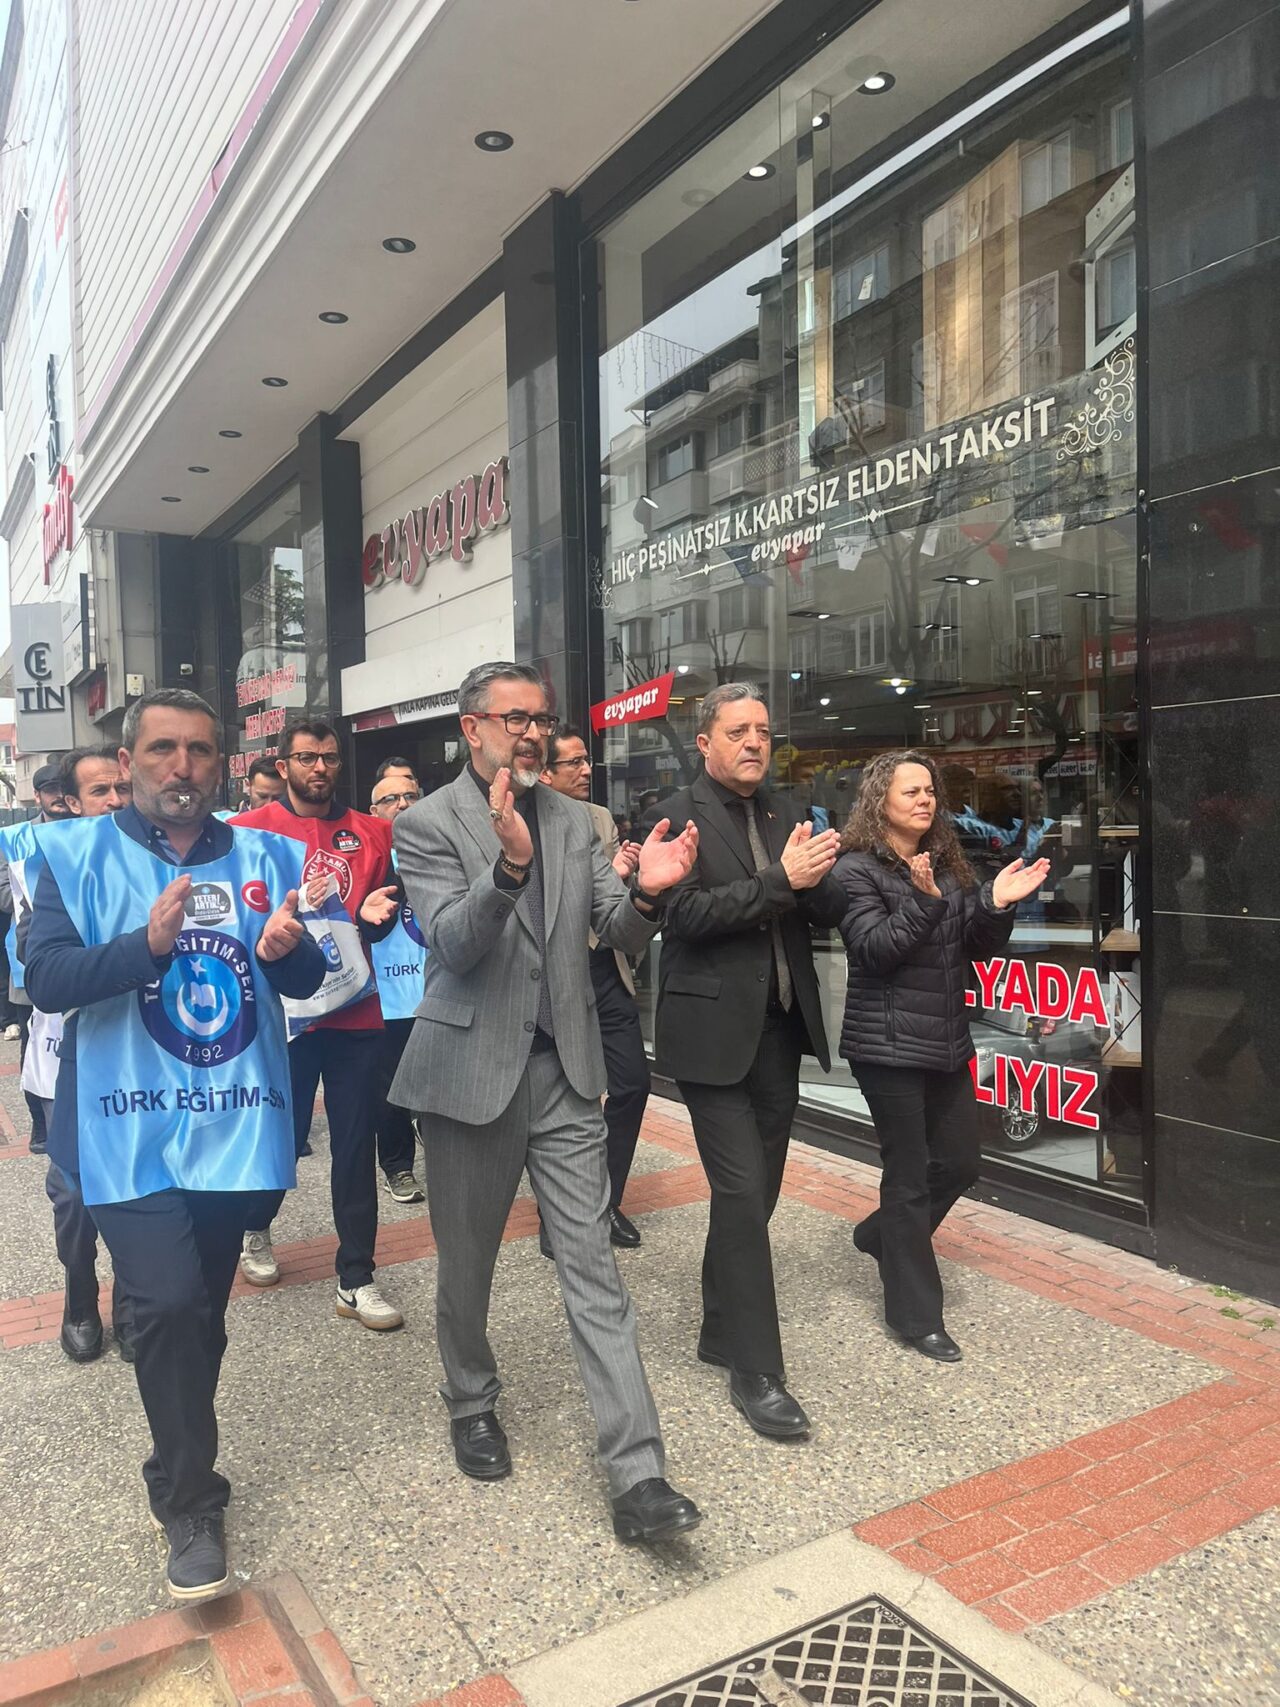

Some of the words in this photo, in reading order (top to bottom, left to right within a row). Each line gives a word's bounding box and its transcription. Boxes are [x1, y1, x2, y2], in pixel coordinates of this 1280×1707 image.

[611, 551, 635, 583] HİÇ
[638, 515, 731, 571] PEŞİNATSIZ
[735, 476, 840, 541] K.KARTSIZ
[848, 442, 932, 501] ELDEN
[940, 397, 1056, 469] TAKSİT
[363, 456, 511, 587] evyapa
[751, 522, 826, 562] evyapar
[604, 687, 659, 721] evyapar
[175, 931, 256, 1002] ĞİTİM-SEN
[384, 963, 421, 977] TÜRK
[964, 956, 1111, 1028] YADA
[185, 1044, 224, 1062] 1992
[99, 1088, 169, 1118] TÜRK
